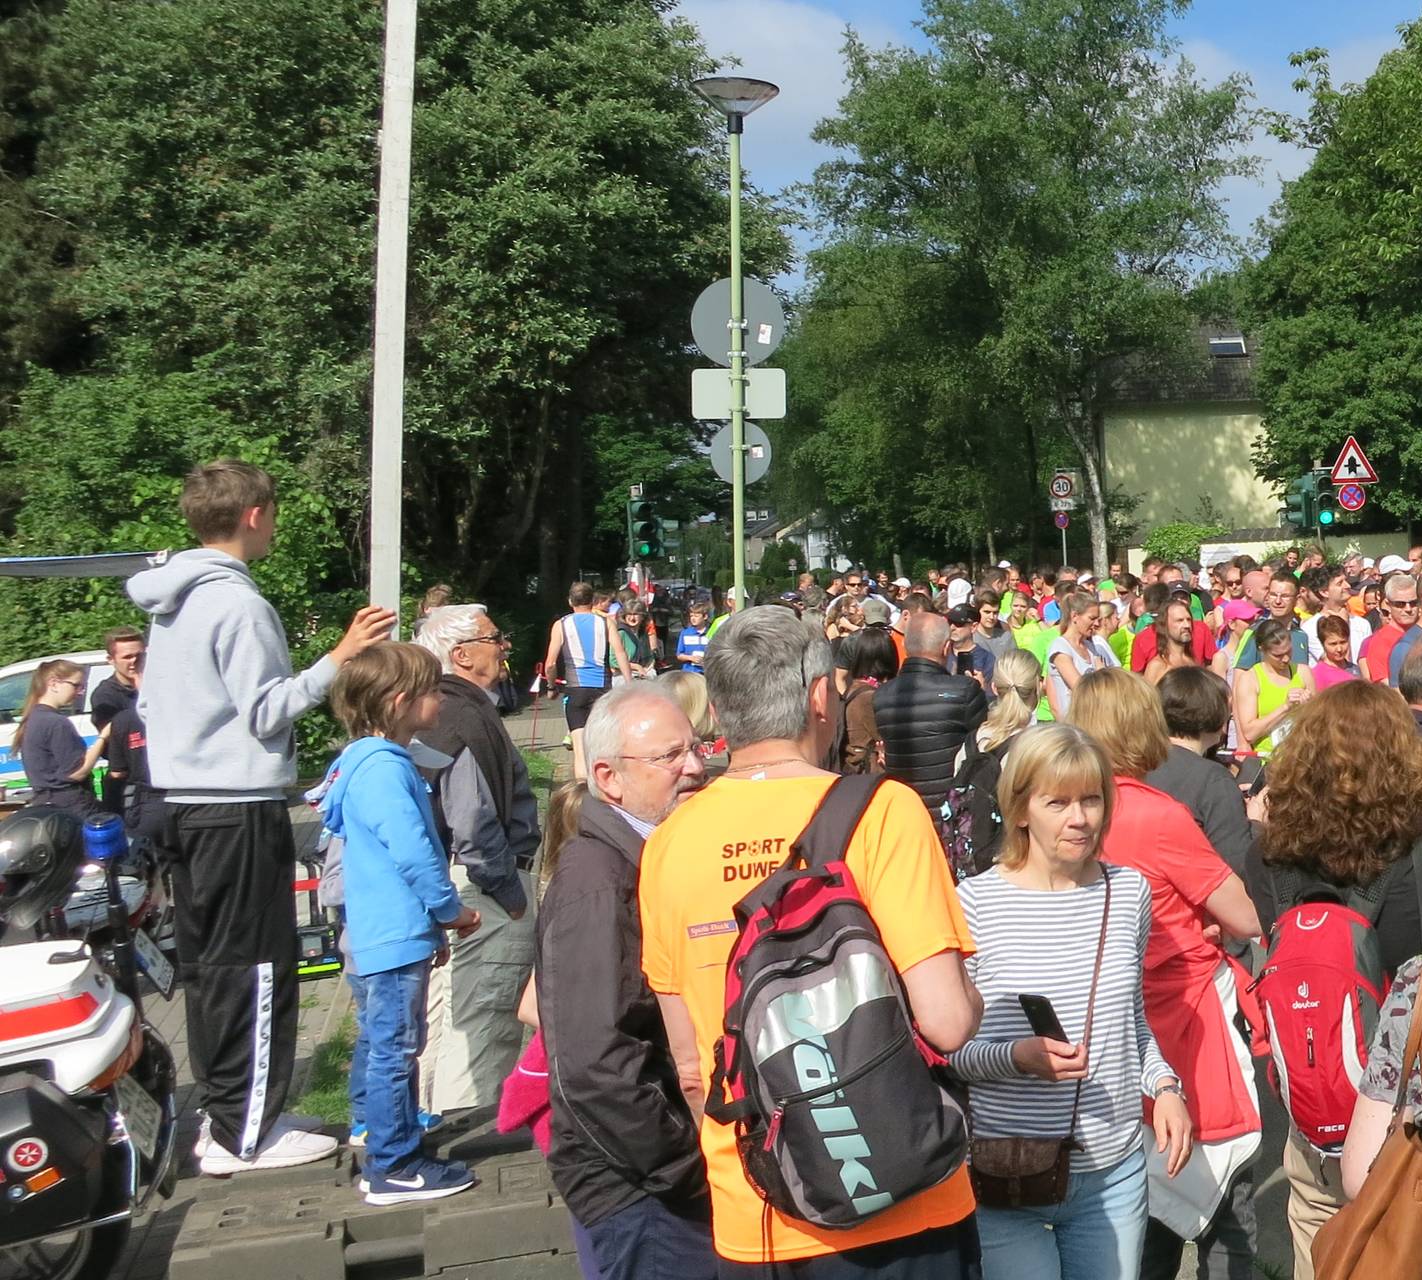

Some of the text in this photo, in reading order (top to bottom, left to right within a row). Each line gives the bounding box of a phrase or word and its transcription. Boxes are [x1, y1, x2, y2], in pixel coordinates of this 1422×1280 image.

[1055, 481, 1069, 492] 30
[722, 838, 785, 859] SPORT
[1292, 1000, 1320, 1010] deuter
[1318, 1124, 1345, 1133] race
